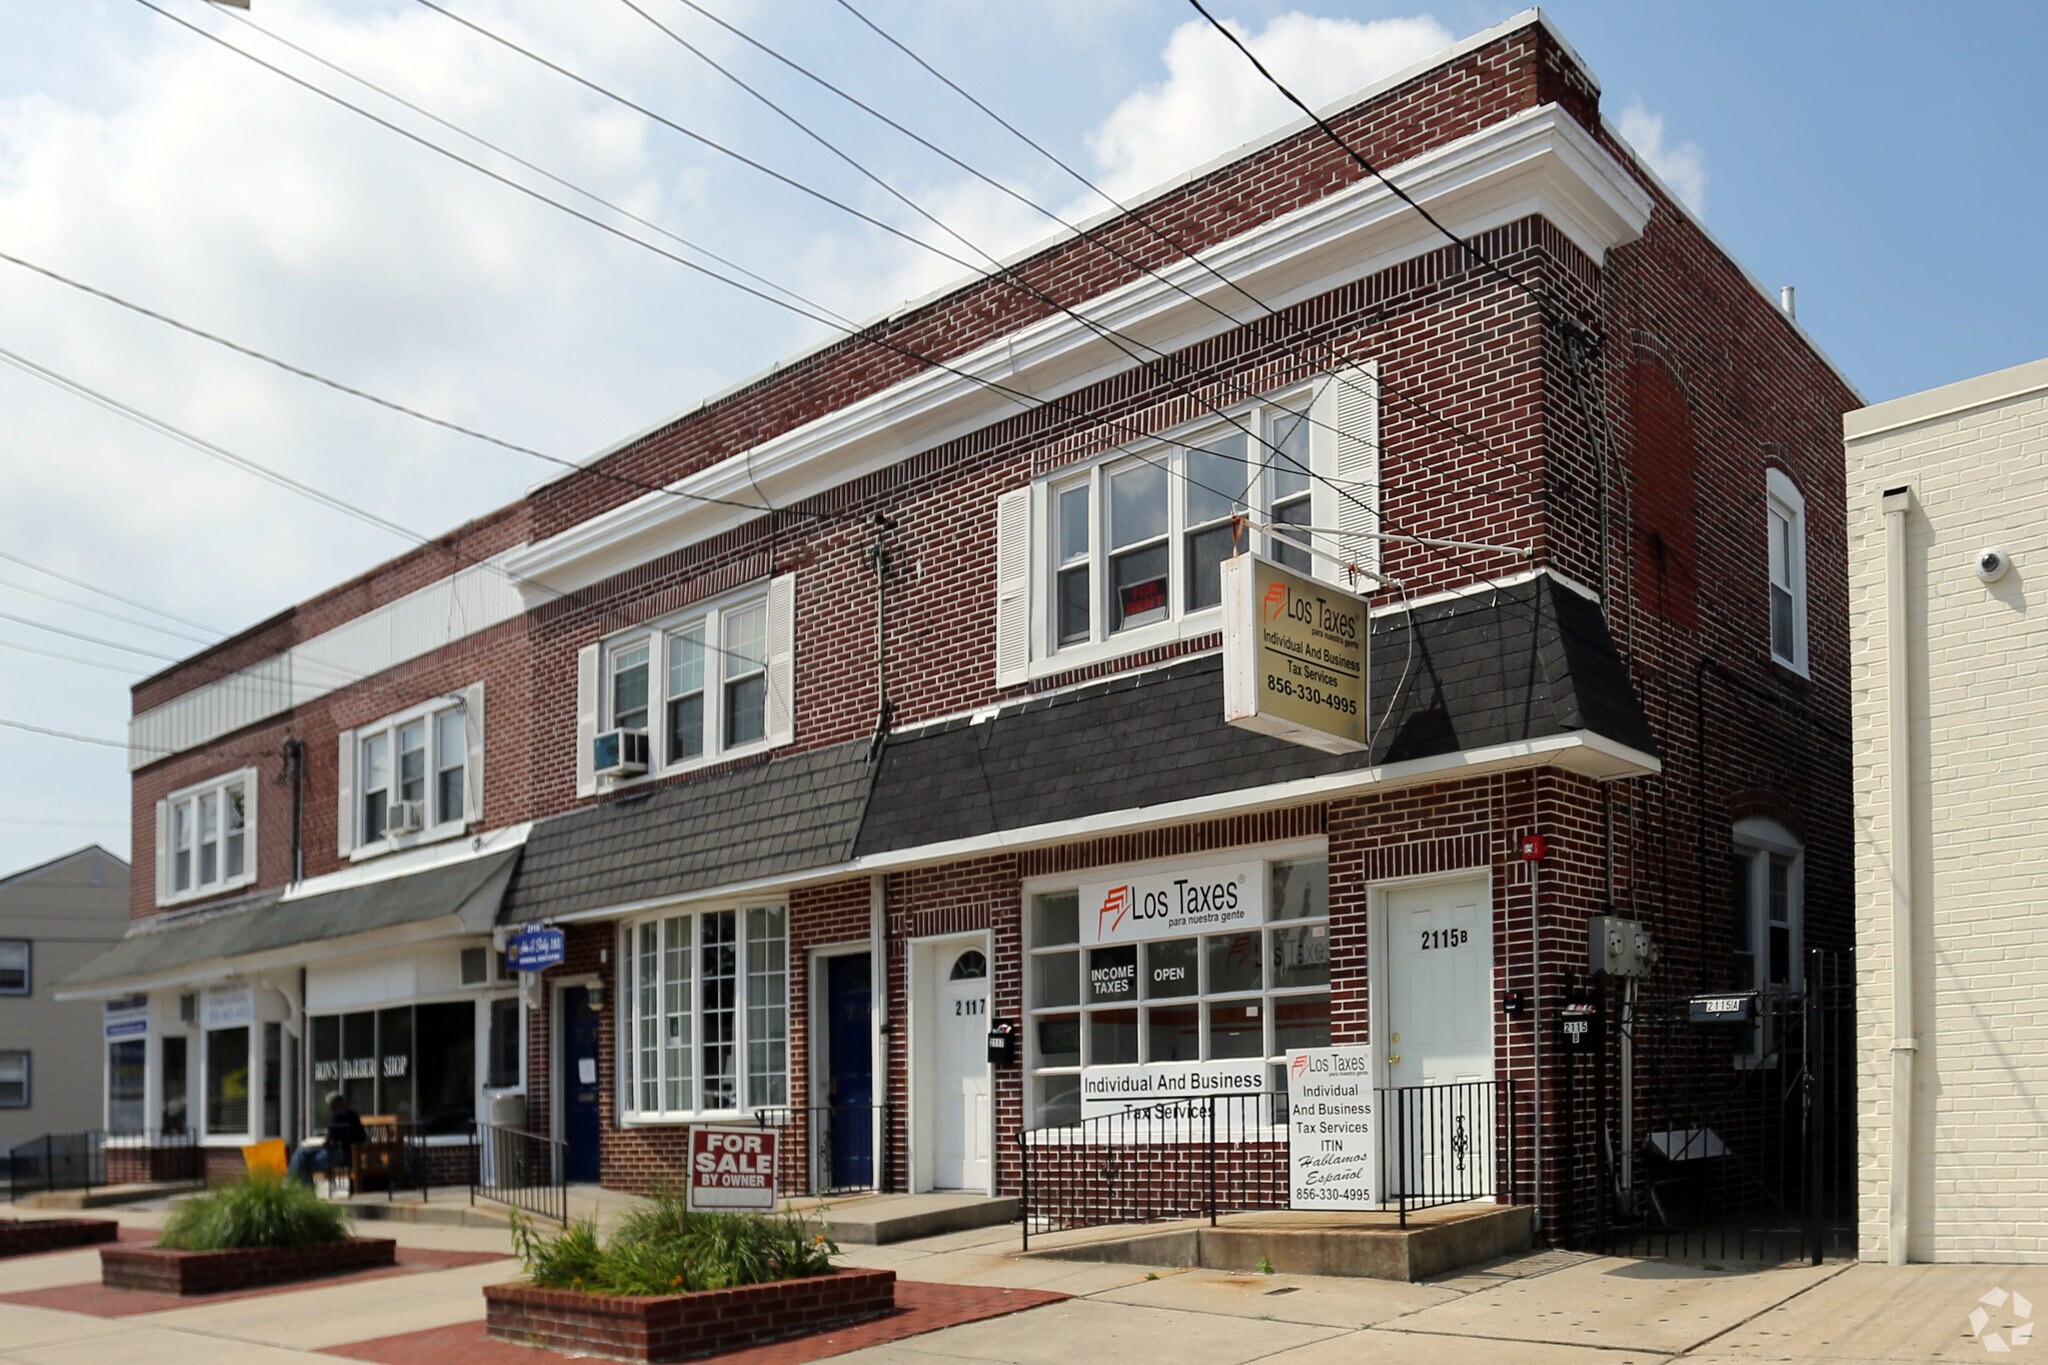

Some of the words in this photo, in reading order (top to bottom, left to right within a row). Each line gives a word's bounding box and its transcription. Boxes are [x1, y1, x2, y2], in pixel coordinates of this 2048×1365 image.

[1287, 587, 1312, 625] Los
[1316, 597, 1355, 639] Taxes
[1263, 628, 1303, 654] Individual
[1305, 643, 1321, 660] And
[1324, 649, 1360, 672] Business
[1287, 660, 1302, 675] Tax
[1304, 665, 1338, 687] Services
[1267, 674, 1357, 715] 856-330-4995
[1131, 886, 1168, 920] Los
[1174, 879, 1237, 914] Taxes
[1168, 916, 1187, 929] para
[1188, 912, 1219, 925] nuestra
[1221, 908, 1244, 923] gente
[1091, 965, 1135, 981] INCOME
[1153, 967, 1185, 981] OPEN
[1094, 979, 1129, 994] TAXES
[956, 998, 985, 1016] 2117
[1708, 1001, 1738, 1011] 2115A
[1565, 1022, 1587, 1033] 2115
[1573, 1032, 1580, 1043] B
[342, 1058, 376, 1079] BARBER
[383, 1055, 408, 1077] SHOP
[1309, 1055, 1329, 1072] Los
[1331, 1054, 1365, 1071] Taxes
[1084, 1076, 1152, 1093] Individual
[1157, 1074, 1186, 1090] And
[1191, 1072, 1262, 1090] Business
[1303, 1084, 1359, 1097] Individual
[1124, 1105, 1150, 1120] Tax
[1293, 1103, 1315, 1115] And
[1319, 1102, 1371, 1115] Business
[1296, 1122, 1316, 1133] Tax
[1319, 1122, 1368, 1133] Services
[707, 1133, 762, 1153] FOR
[1321, 1140, 1343, 1151] ITIN
[695, 1152, 772, 1174] SALE
[1298, 1152, 1367, 1168] Hablamos
[702, 1174, 719, 1186] BY
[722, 1174, 765, 1187] OWNER
[1305, 1167, 1363, 1186] Español
[1296, 1188, 1370, 1200] 856-330-4995
